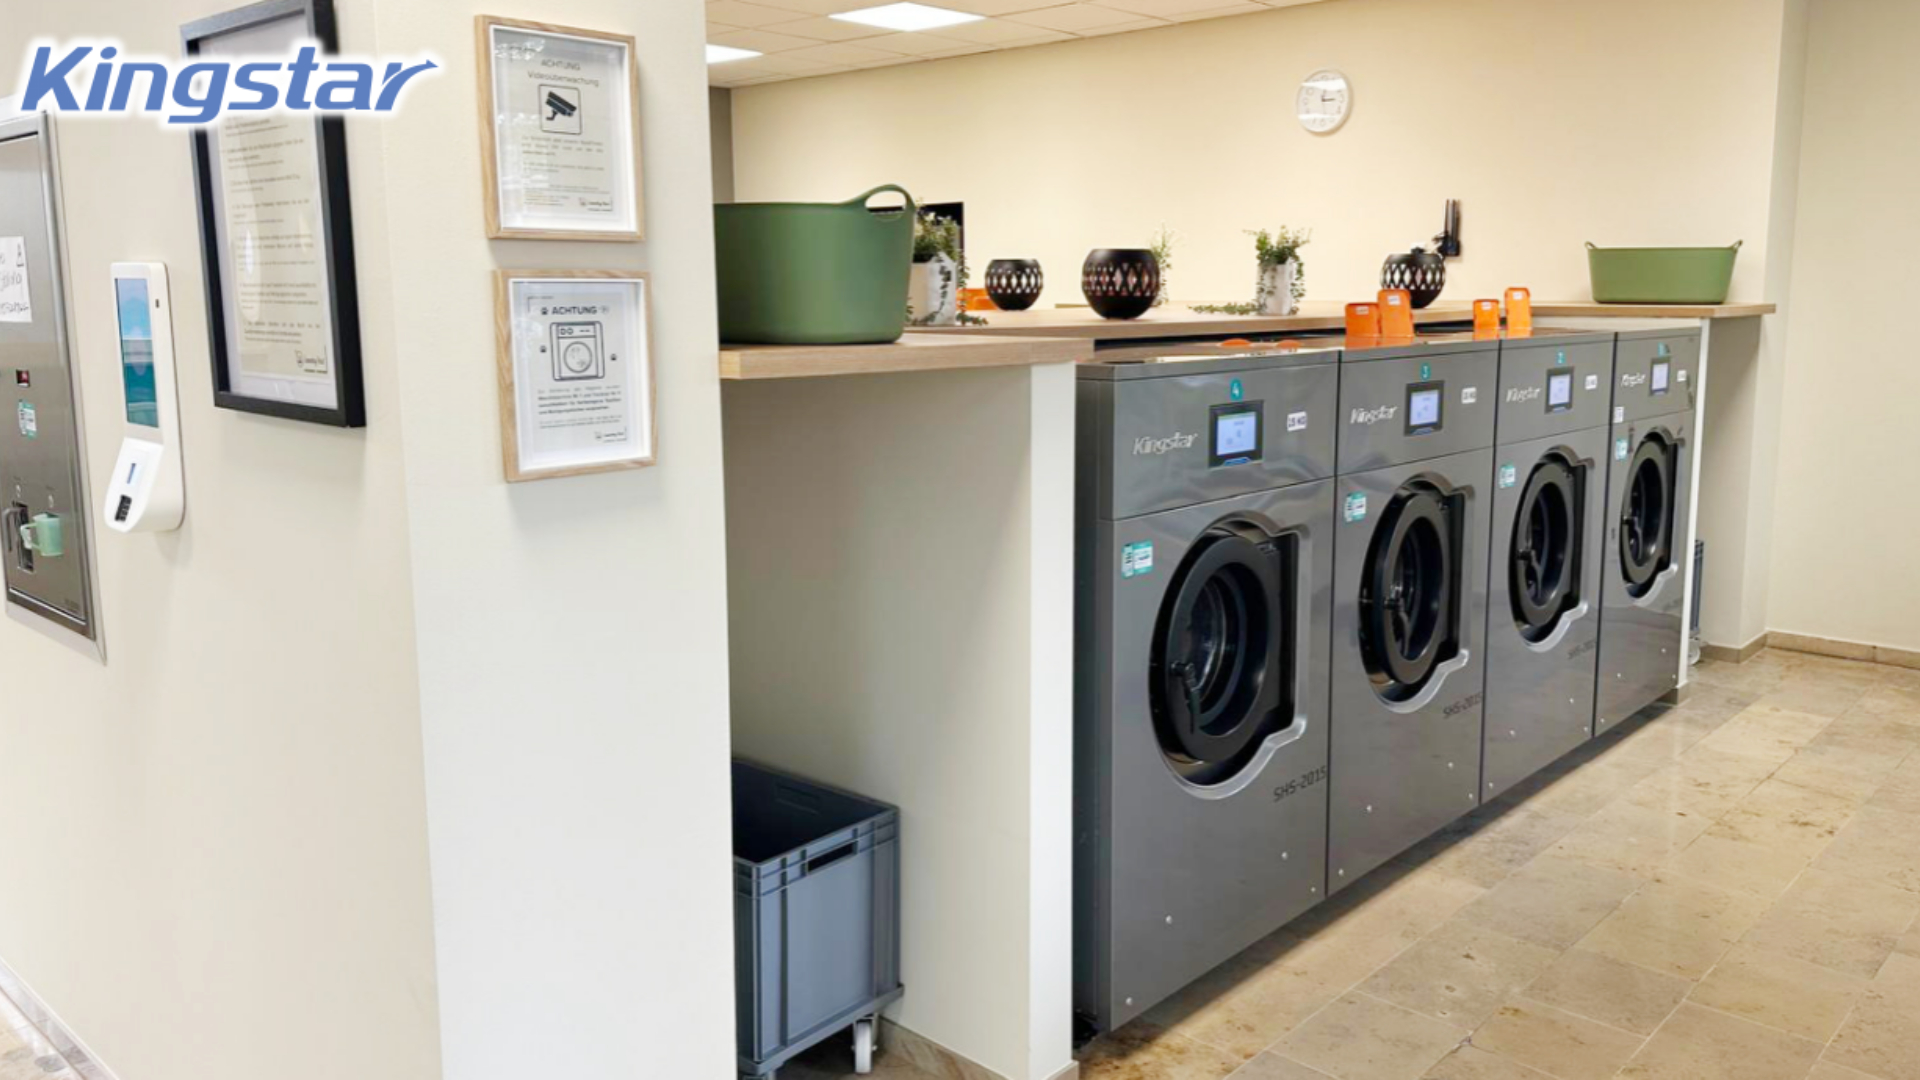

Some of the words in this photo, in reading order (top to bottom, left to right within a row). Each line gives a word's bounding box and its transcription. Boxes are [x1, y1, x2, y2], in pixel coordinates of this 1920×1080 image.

[551, 306, 598, 315] ACHTUNG
[1133, 431, 1199, 455] Kingstar
[1273, 764, 1327, 803] SHS-2015
